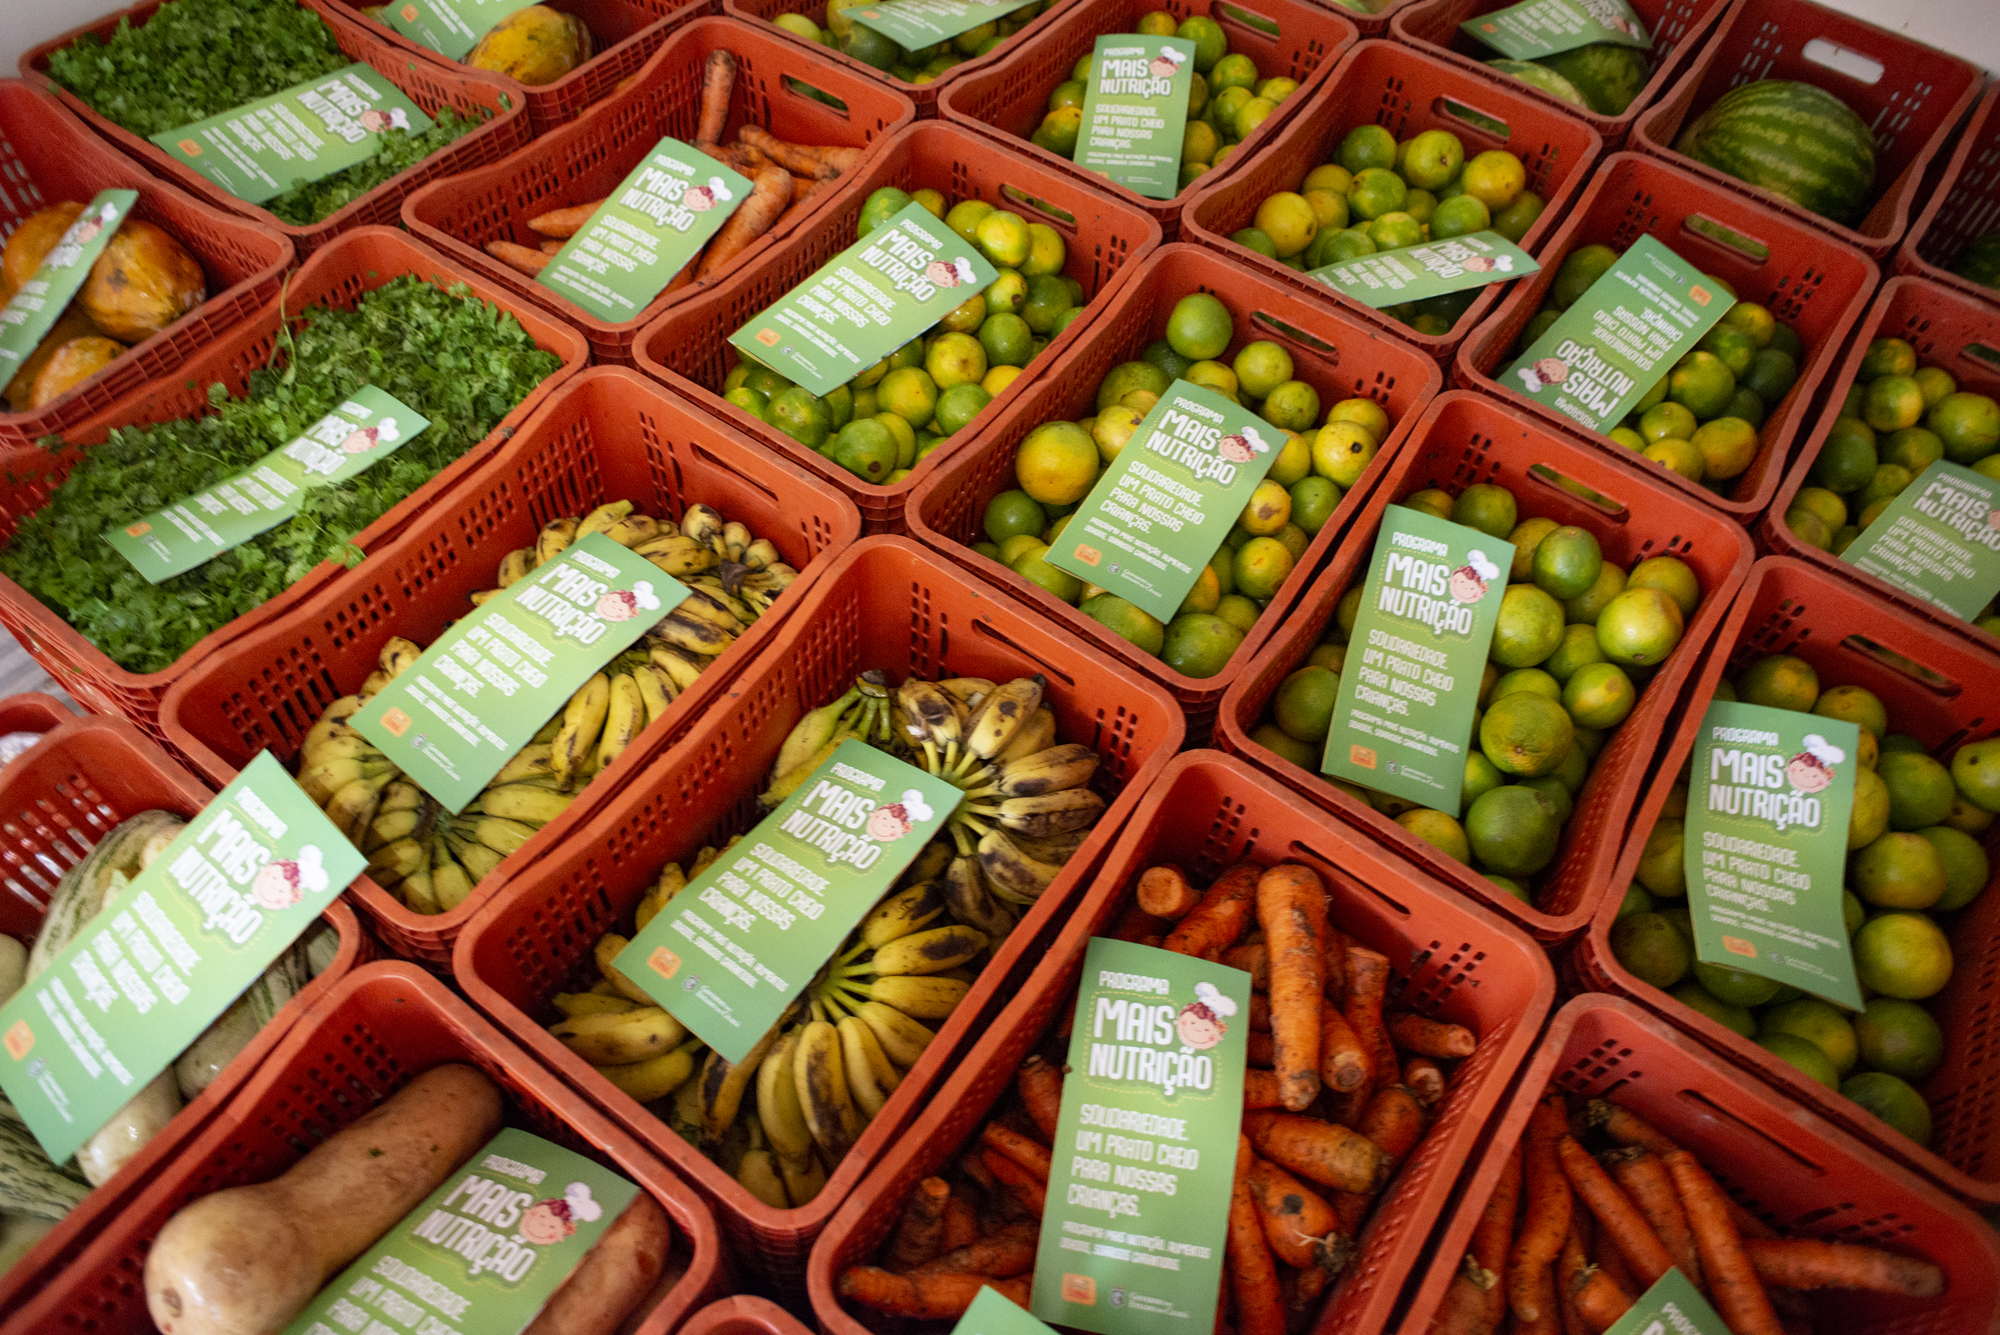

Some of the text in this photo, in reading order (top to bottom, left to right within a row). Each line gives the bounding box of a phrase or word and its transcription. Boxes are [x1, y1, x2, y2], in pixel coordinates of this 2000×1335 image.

[1099, 77, 1170, 98] NUTRIÇÃO
[1101, 58, 1148, 78] MAIS
[296, 89, 367, 143] NUTRIÇÃO
[316, 78, 371, 116] MAIS
[633, 166, 689, 201] MAIS
[619, 187, 695, 231] NUTRIÇÃO
[876, 228, 934, 269] MAIS
[858, 245, 936, 301] NUTRIÇÃO
[808, 284, 869, 328] PARA NOSSAS
[821, 274, 892, 326] UM PRATO CHEIO
[1555, 340, 1634, 396] NUTRIÇÃO
[1172, 396, 1224, 424] PROGRAMA
[1561, 371, 1619, 418] MAIS
[1157, 409, 1221, 450] MAIS
[1145, 430, 1236, 484] NUTRIÇÃO
[1118, 473, 1205, 524] UM PRATO CHEIO
[1127, 460, 1203, 507] SOLIDARIEDADE.
[1923, 481, 1990, 519] MAIS
[1099, 499, 1152, 533] CRIANÇAS.
[1108, 486, 1184, 532] PARA NOSSAS
[1391, 531, 1448, 556] PROGRAMA
[538, 562, 608, 606] MAIS
[1384, 552, 1450, 596] MAIS
[514, 584, 606, 644] NUTRIÇÃO
[1377, 585, 1472, 634] NUTRIÇÃO
[1357, 665, 1436, 706] PARA NOSSAS
[1362, 647, 1454, 691] UM PRATO CHEIO
[1710, 747, 1786, 788] MAIS
[801, 779, 876, 829] MAIS
[1708, 783, 1820, 830] NUTRIÇÃO
[193, 807, 271, 884] MAIS
[779, 808, 881, 869] NUTRIÇÃO
[167, 844, 263, 944] NUTRIÇÃO
[715, 870, 796, 930] PARA NOSSAS
[732, 856, 825, 920] UM PRATO CHEIO
[1093, 997, 1177, 1045] MAIS
[1088, 1042, 1212, 1095] NUTRIÇÃO
[1075, 1129, 1199, 1170] UM PRATO CHEIO
[1070, 1155, 1177, 1195] PARA NOSSAS
[442, 1174, 533, 1228] MAIS
[412, 1208, 536, 1281] NUTRIÇÃO
